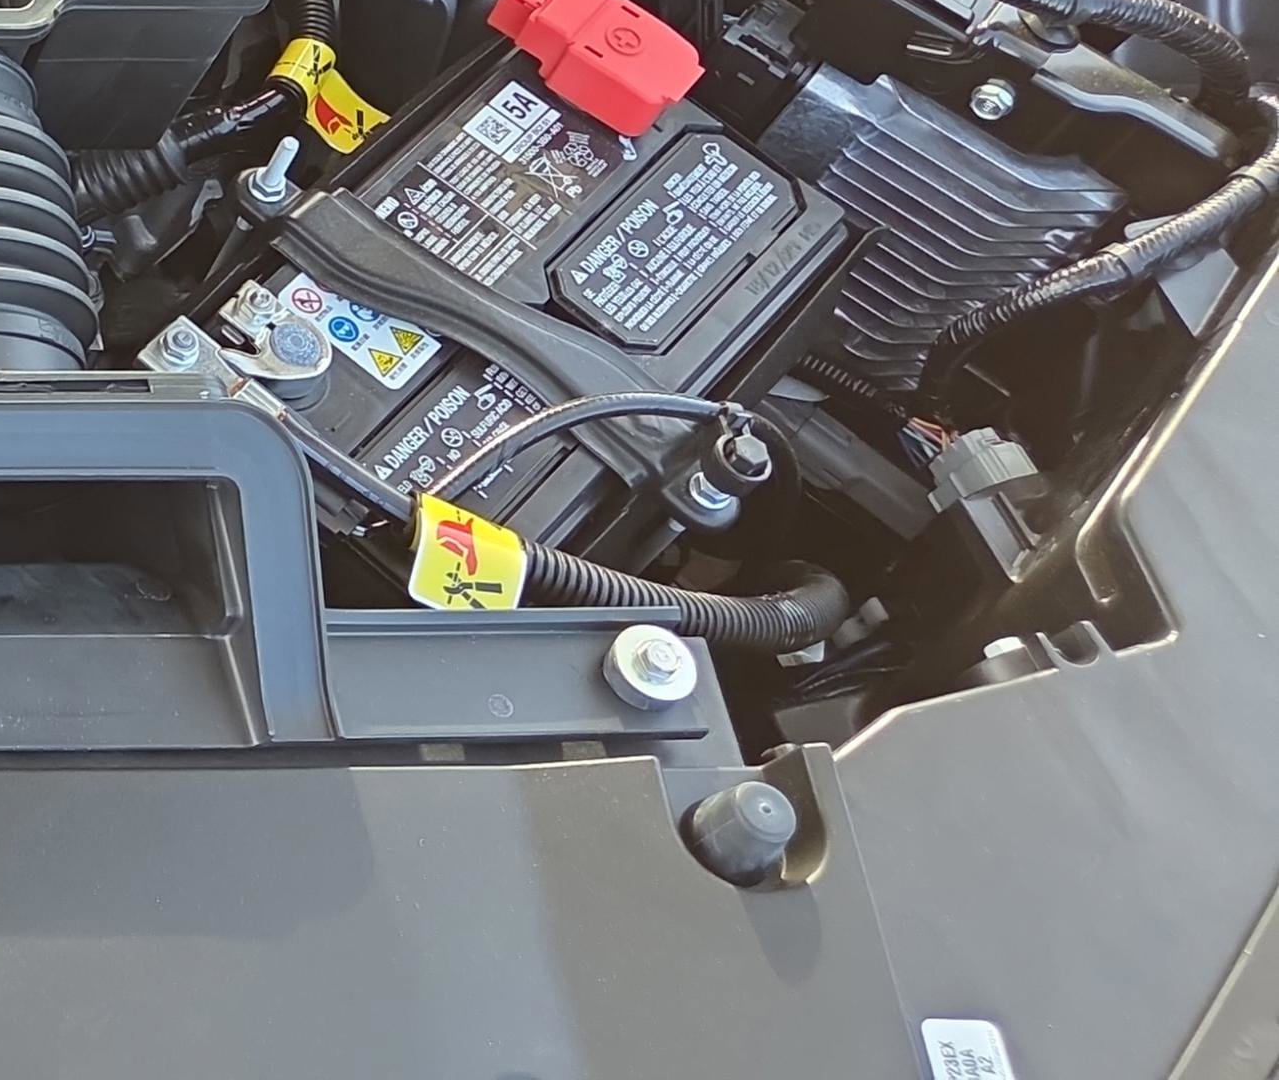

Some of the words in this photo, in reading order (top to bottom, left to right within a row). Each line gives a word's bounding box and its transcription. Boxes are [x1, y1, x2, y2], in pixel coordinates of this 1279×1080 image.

[501, 88, 538, 120] 5A
[580, 234, 621, 275] DANGER
[619, 197, 658, 234] POISON
[383, 425, 430, 469] DANGER
[426, 384, 472, 426] POISON
